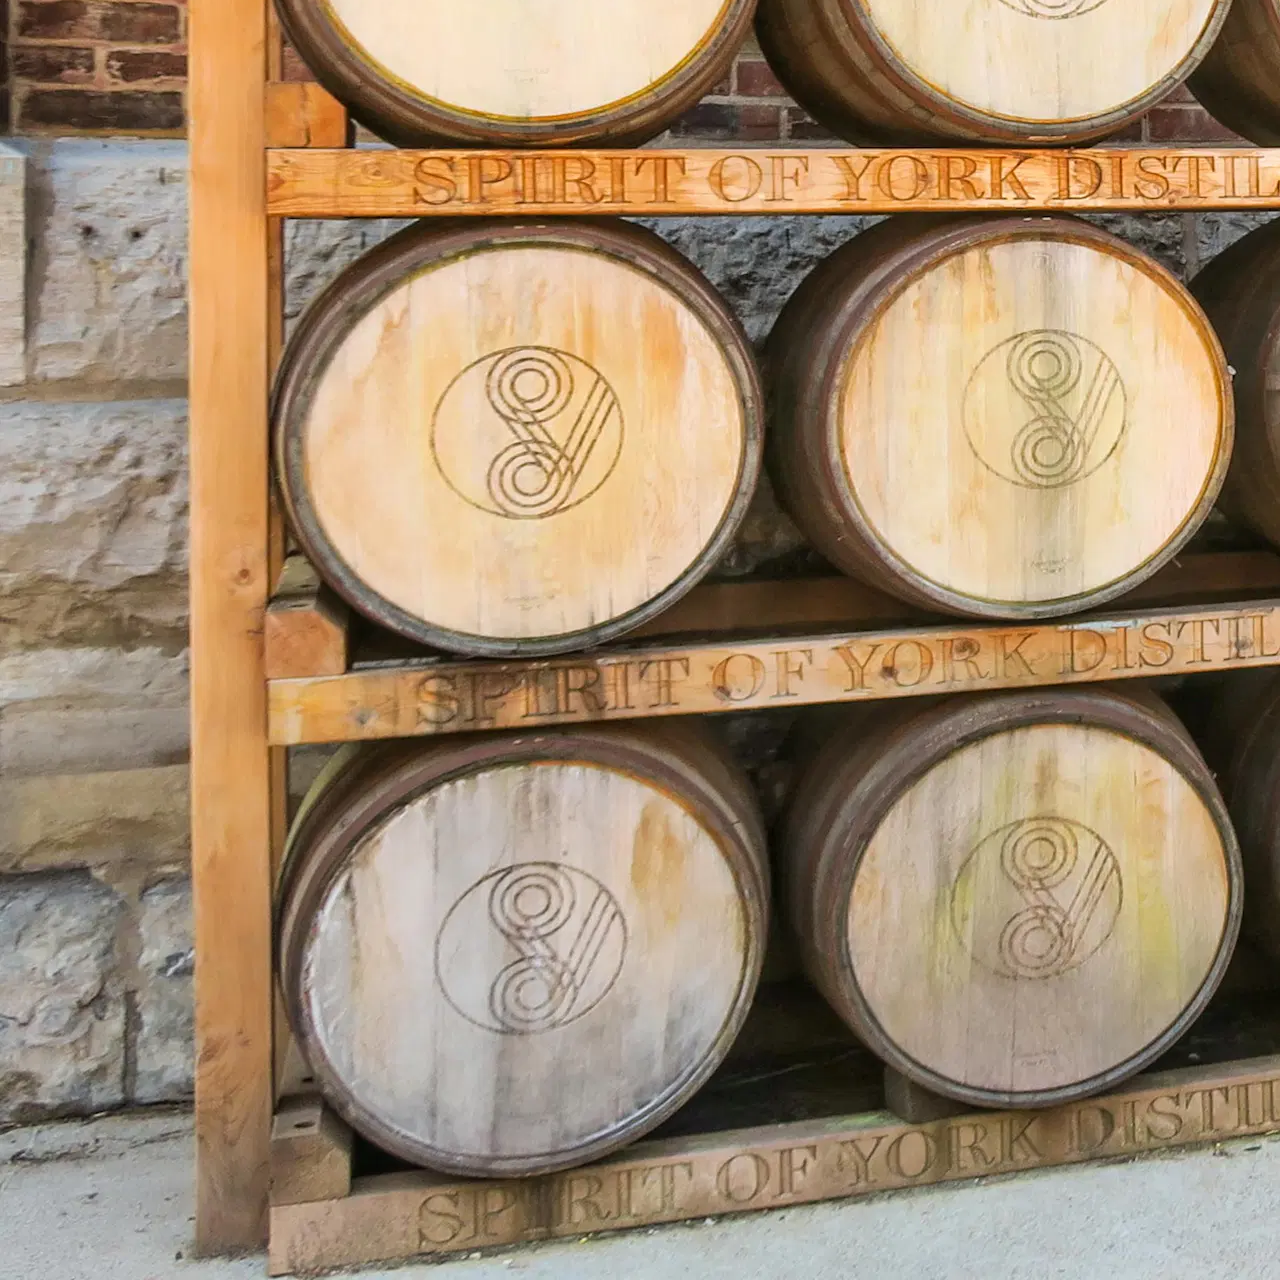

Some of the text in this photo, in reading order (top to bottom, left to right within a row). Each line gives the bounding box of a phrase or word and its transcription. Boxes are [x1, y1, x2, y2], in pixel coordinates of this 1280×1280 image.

[411, 154, 686, 206] SPIRIT
[709, 154, 809, 203] OF
[828, 154, 1038, 202] YORK
[417, 656, 692, 727] SPIRIT
[711, 648, 815, 704] OF
[829, 635, 1038, 694] YORK
[417, 1159, 695, 1245] SPIRIT
[715, 1142, 820, 1202] OF
[838, 1122, 1048, 1183] YORK
